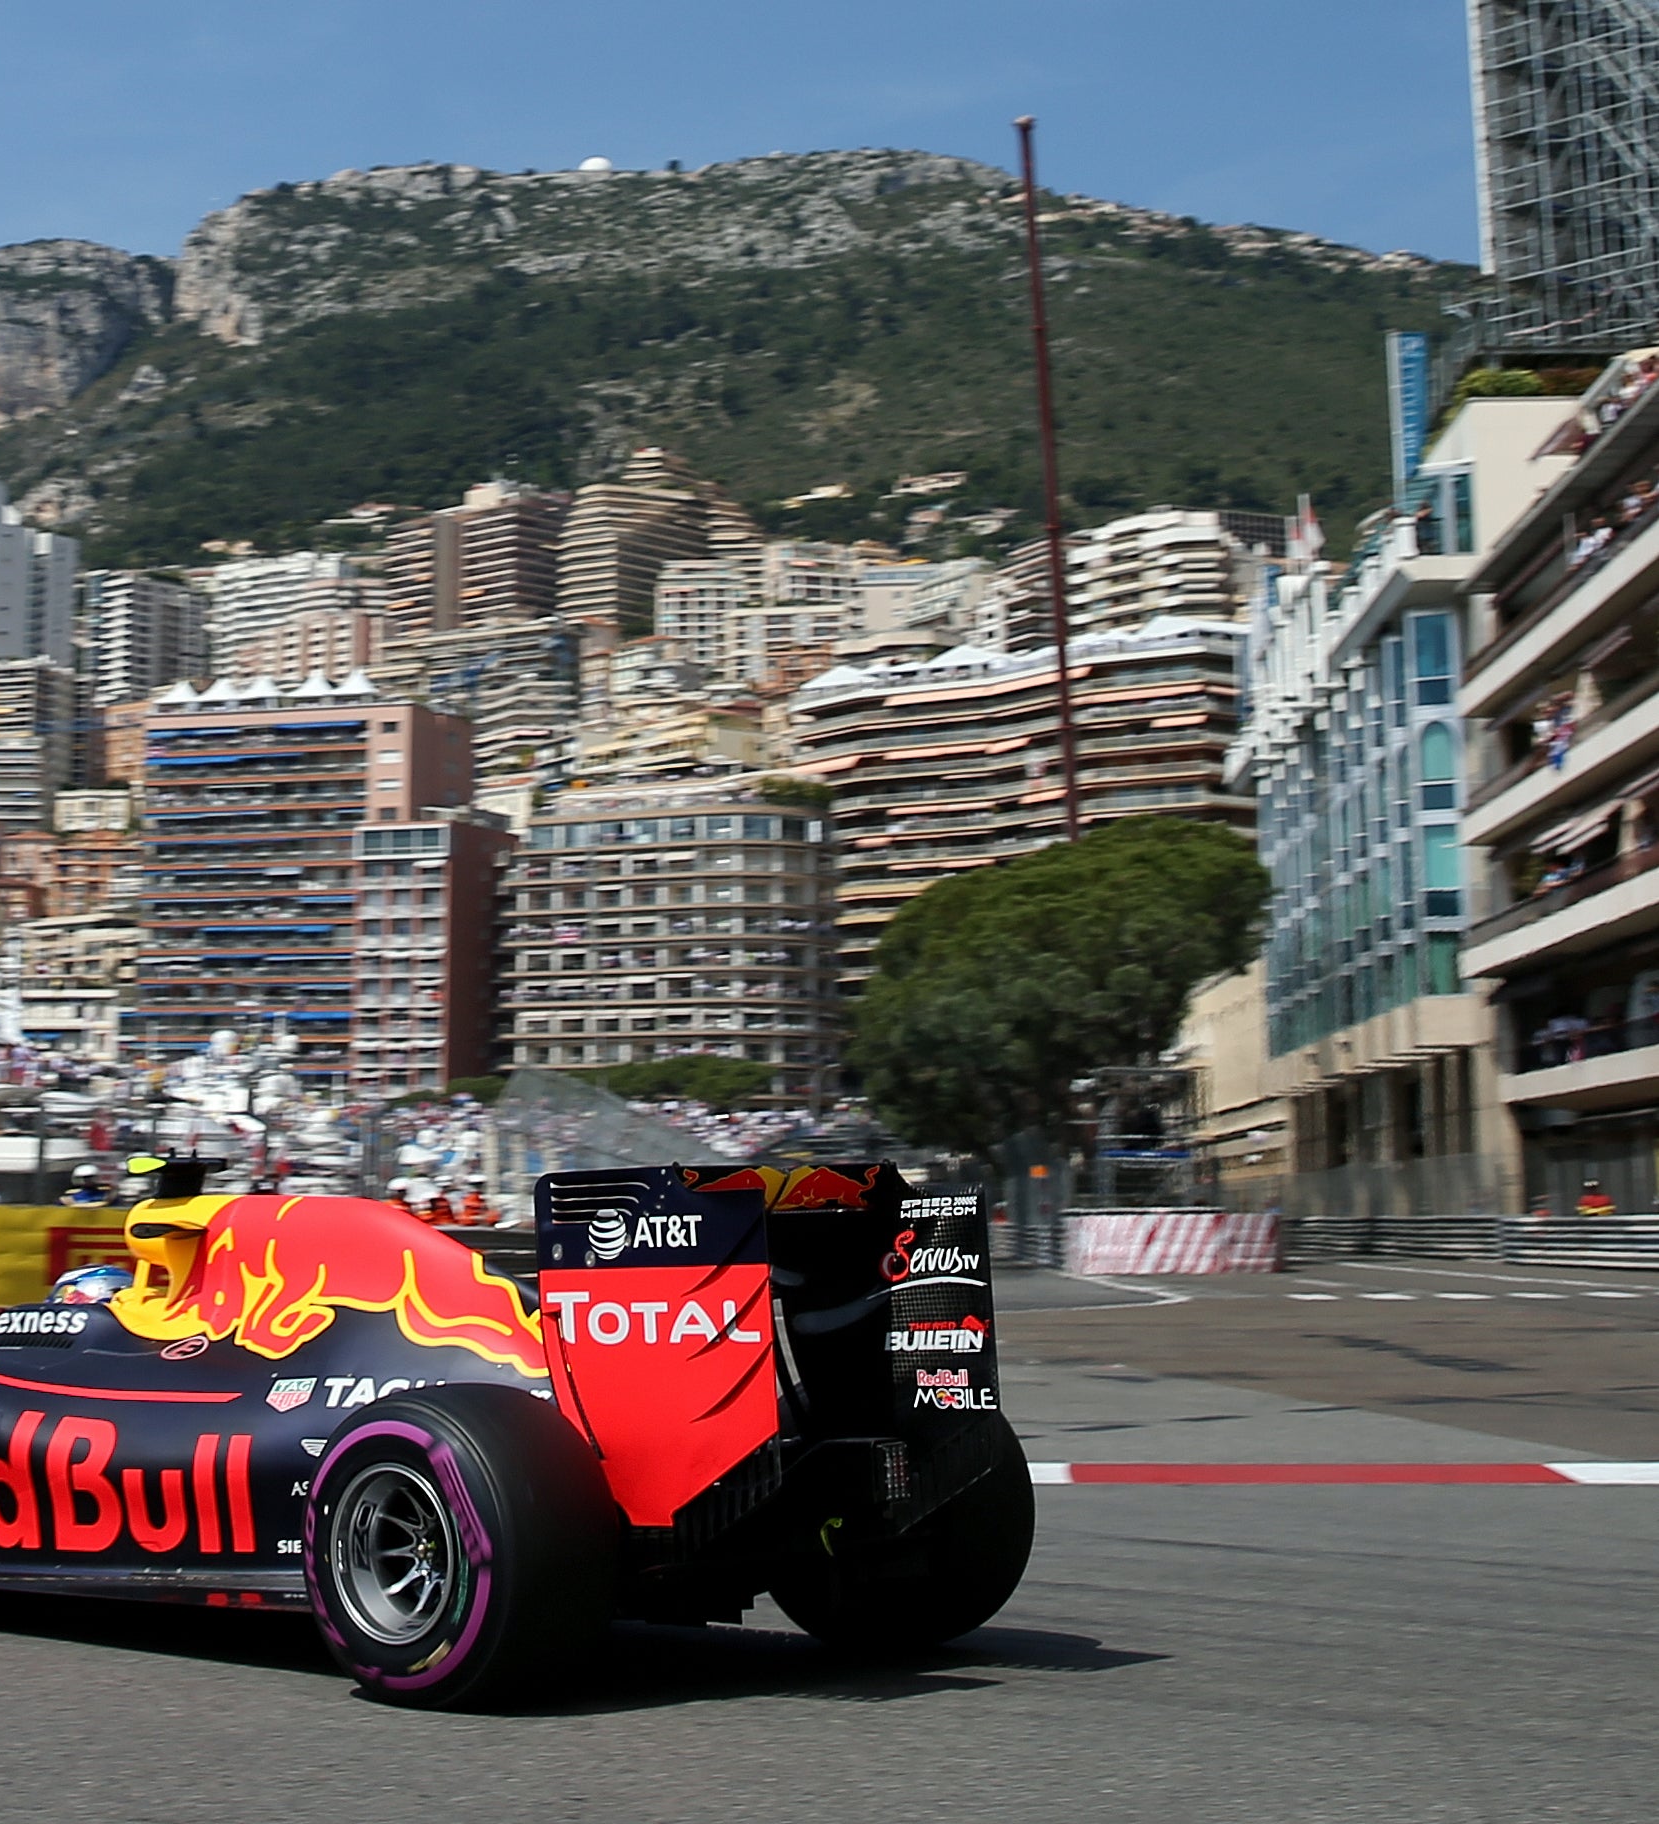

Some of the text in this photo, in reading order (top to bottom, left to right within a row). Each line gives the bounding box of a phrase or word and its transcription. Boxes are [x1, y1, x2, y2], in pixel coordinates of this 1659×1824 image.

[901, 1197, 952, 1209] SPEED
[633, 1215, 702, 1249] AT&T
[546, 1291, 761, 1345] TOTAL
[913, 1388, 997, 1410] MOBILE
[277, 1539, 303, 1554] SIE
